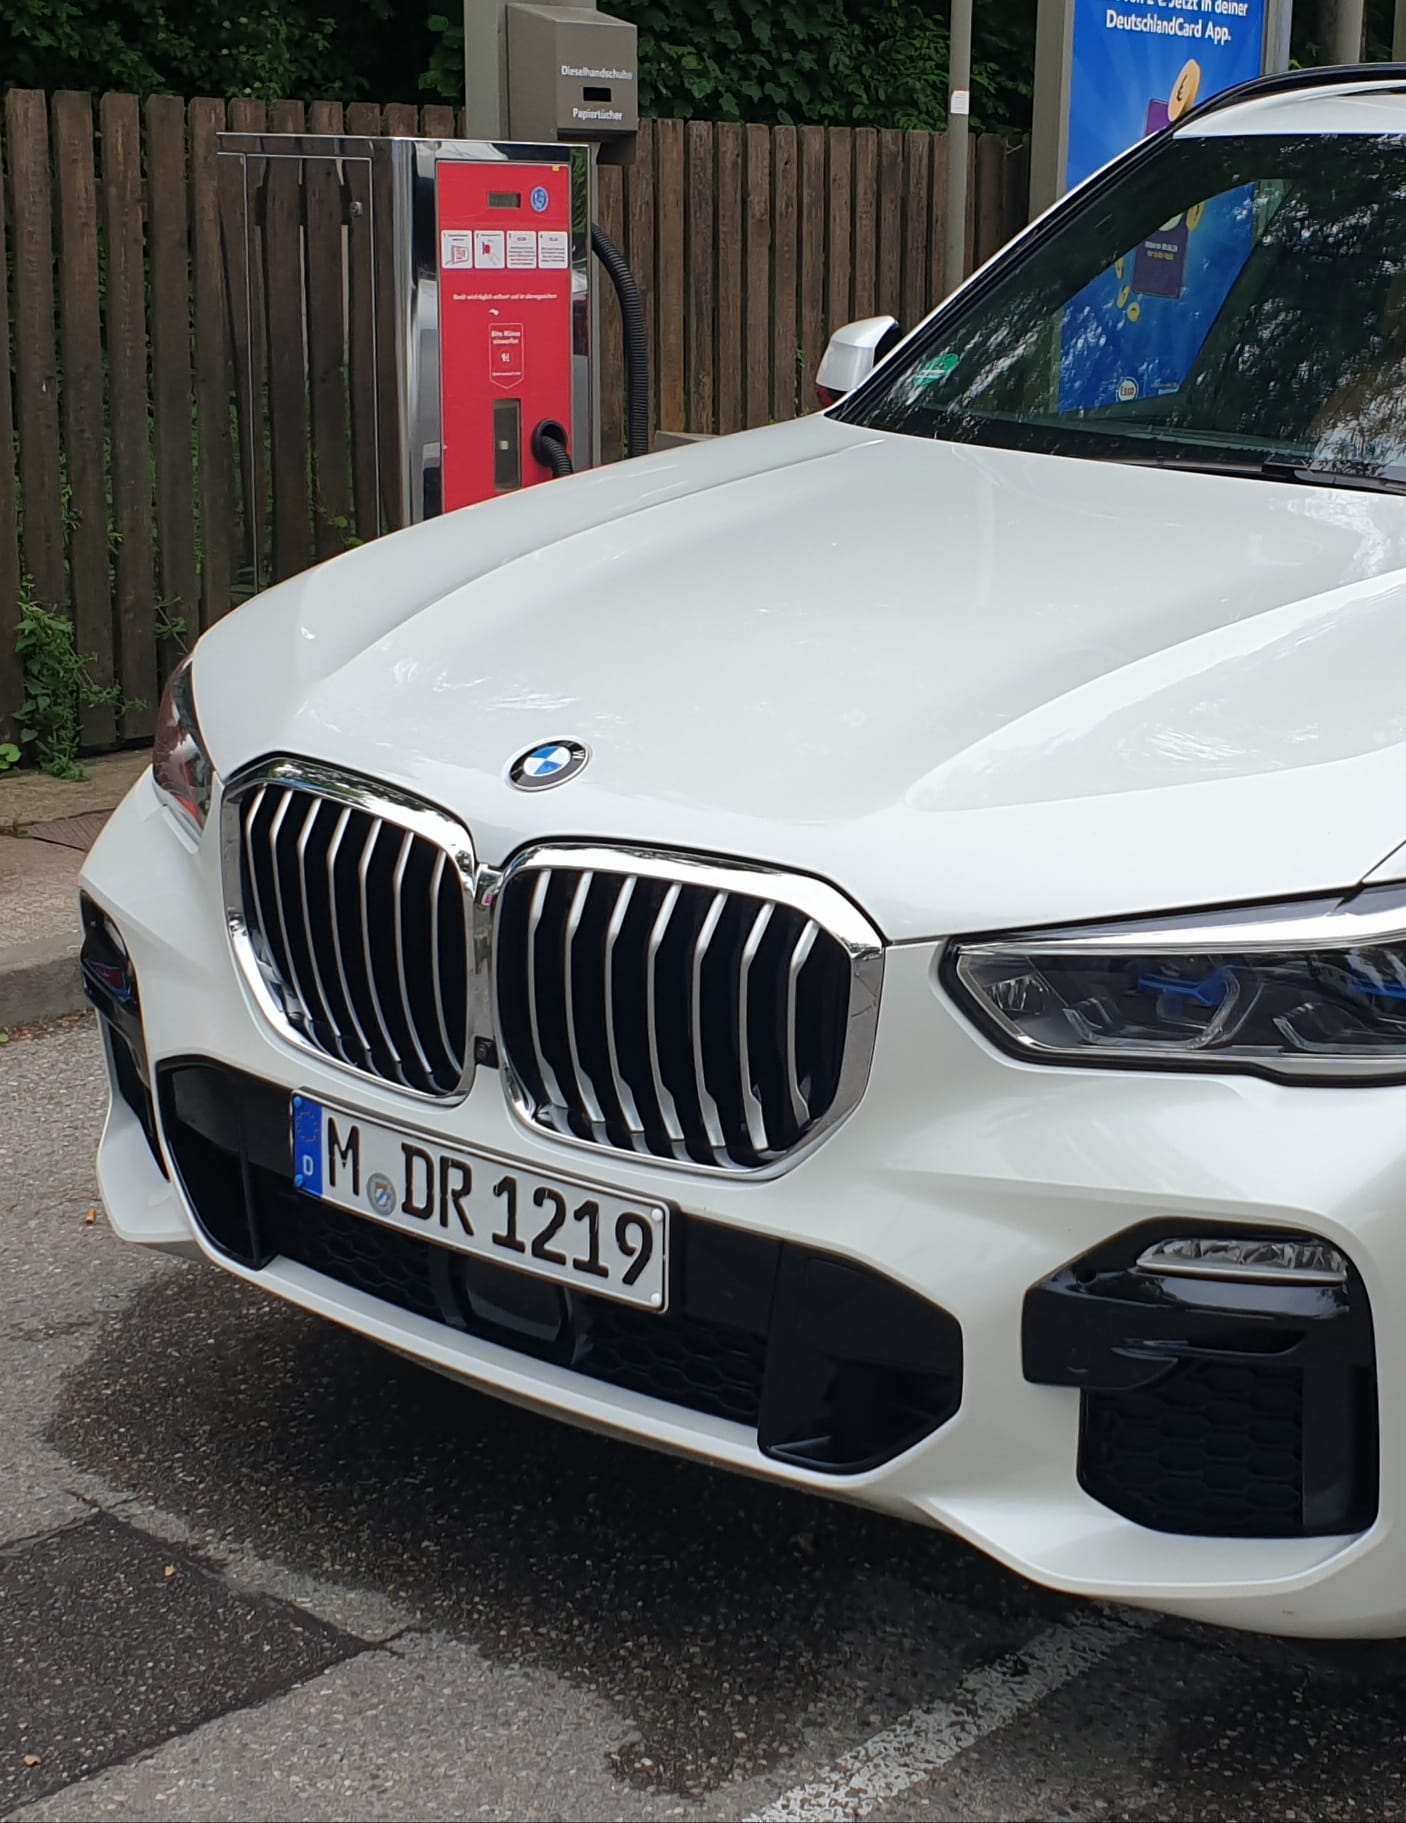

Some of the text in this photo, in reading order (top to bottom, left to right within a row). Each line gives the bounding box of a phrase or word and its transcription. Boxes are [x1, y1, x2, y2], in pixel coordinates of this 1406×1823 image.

[1201, 0, 1212, 13] in
[1214, 0, 1249, 17] deiner
[1106, 9, 1232, 46] DeutschlandCard App.
[302, 1153, 314, 1177] D
[327, 1116, 654, 1286] M DR 1219
